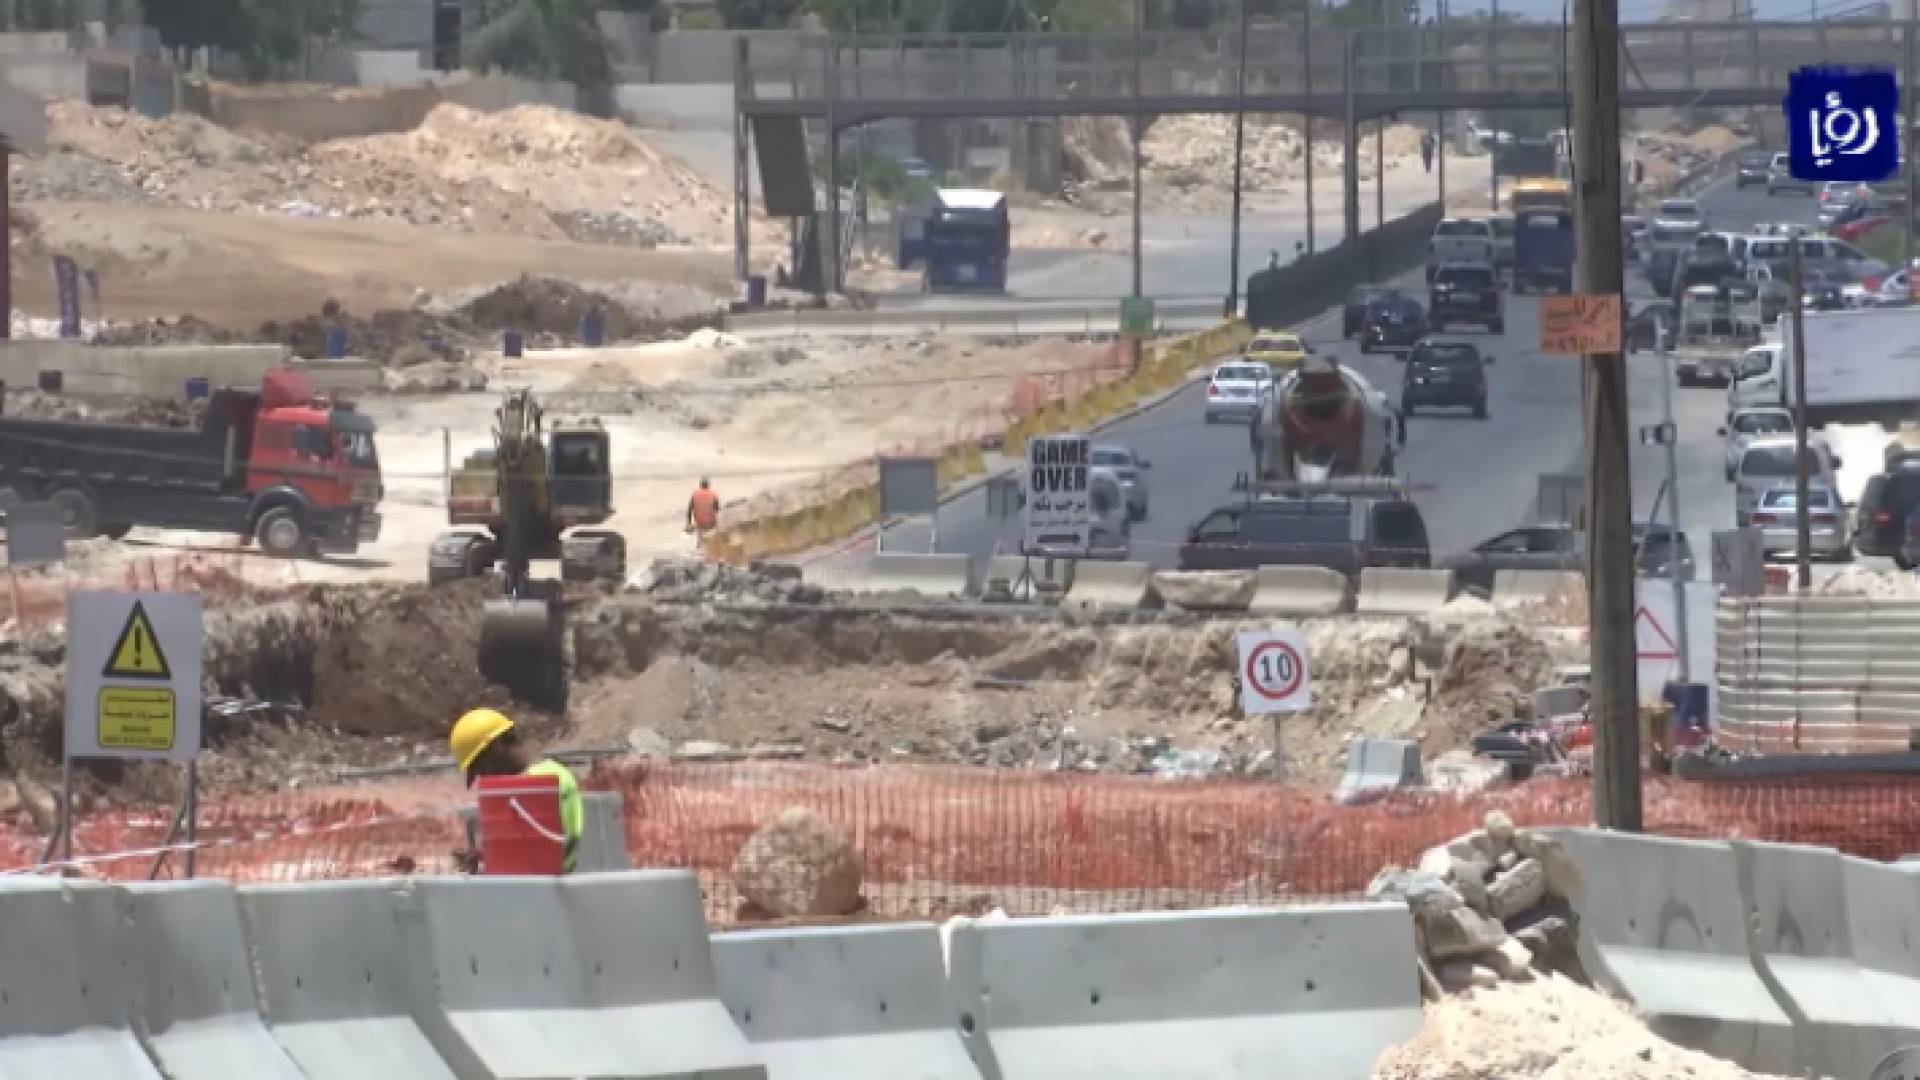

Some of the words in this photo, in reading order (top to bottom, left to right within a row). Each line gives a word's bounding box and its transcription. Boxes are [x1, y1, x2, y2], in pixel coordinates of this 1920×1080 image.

[1032, 439, 1089, 464] GAME
[1032, 466, 1087, 491] OVER
[1260, 652, 1292, 683] 10
